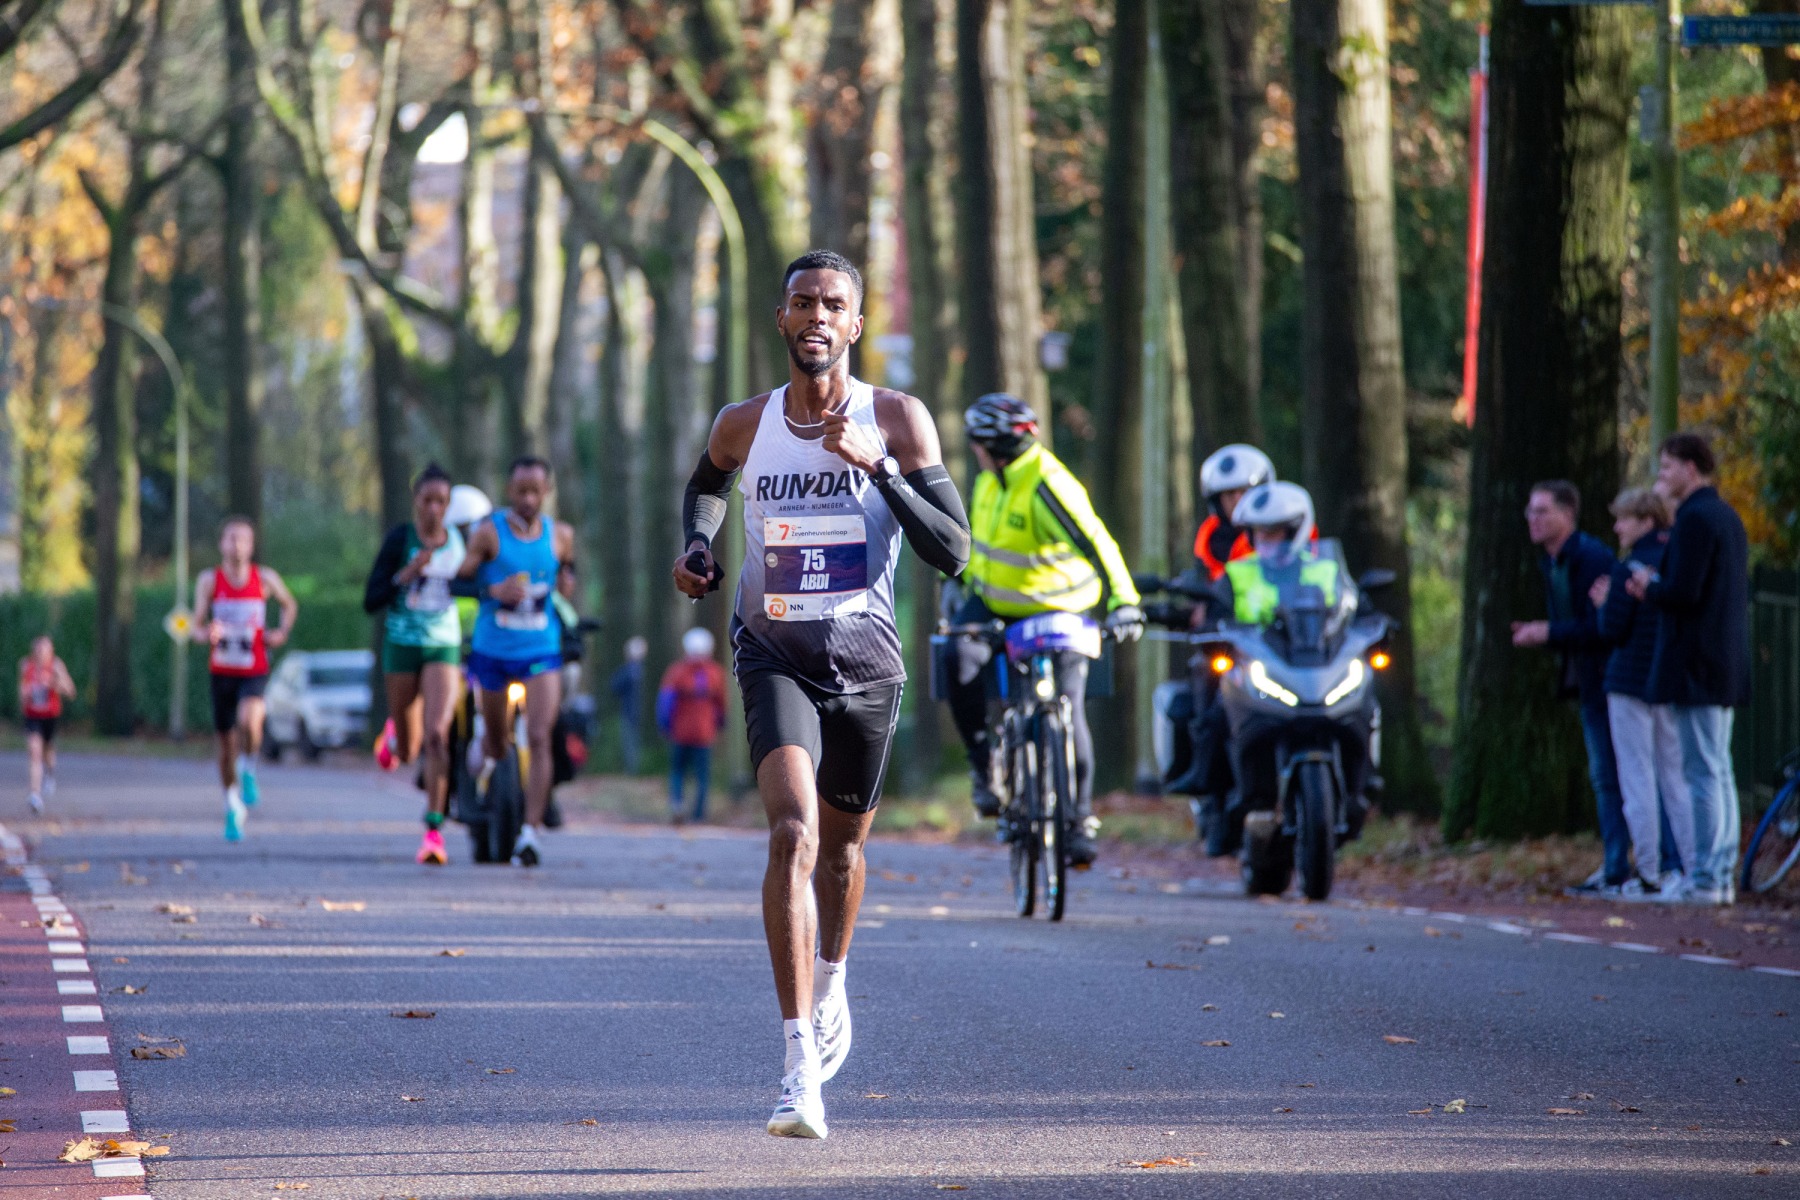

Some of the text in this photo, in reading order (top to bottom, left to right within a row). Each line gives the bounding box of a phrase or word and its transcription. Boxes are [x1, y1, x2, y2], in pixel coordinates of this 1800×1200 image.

[778, 524, 789, 541] 7
[791, 529, 848, 537] Zevenheuvelenloop
[800, 549, 825, 571] 75
[799, 573, 830, 590] ABDI
